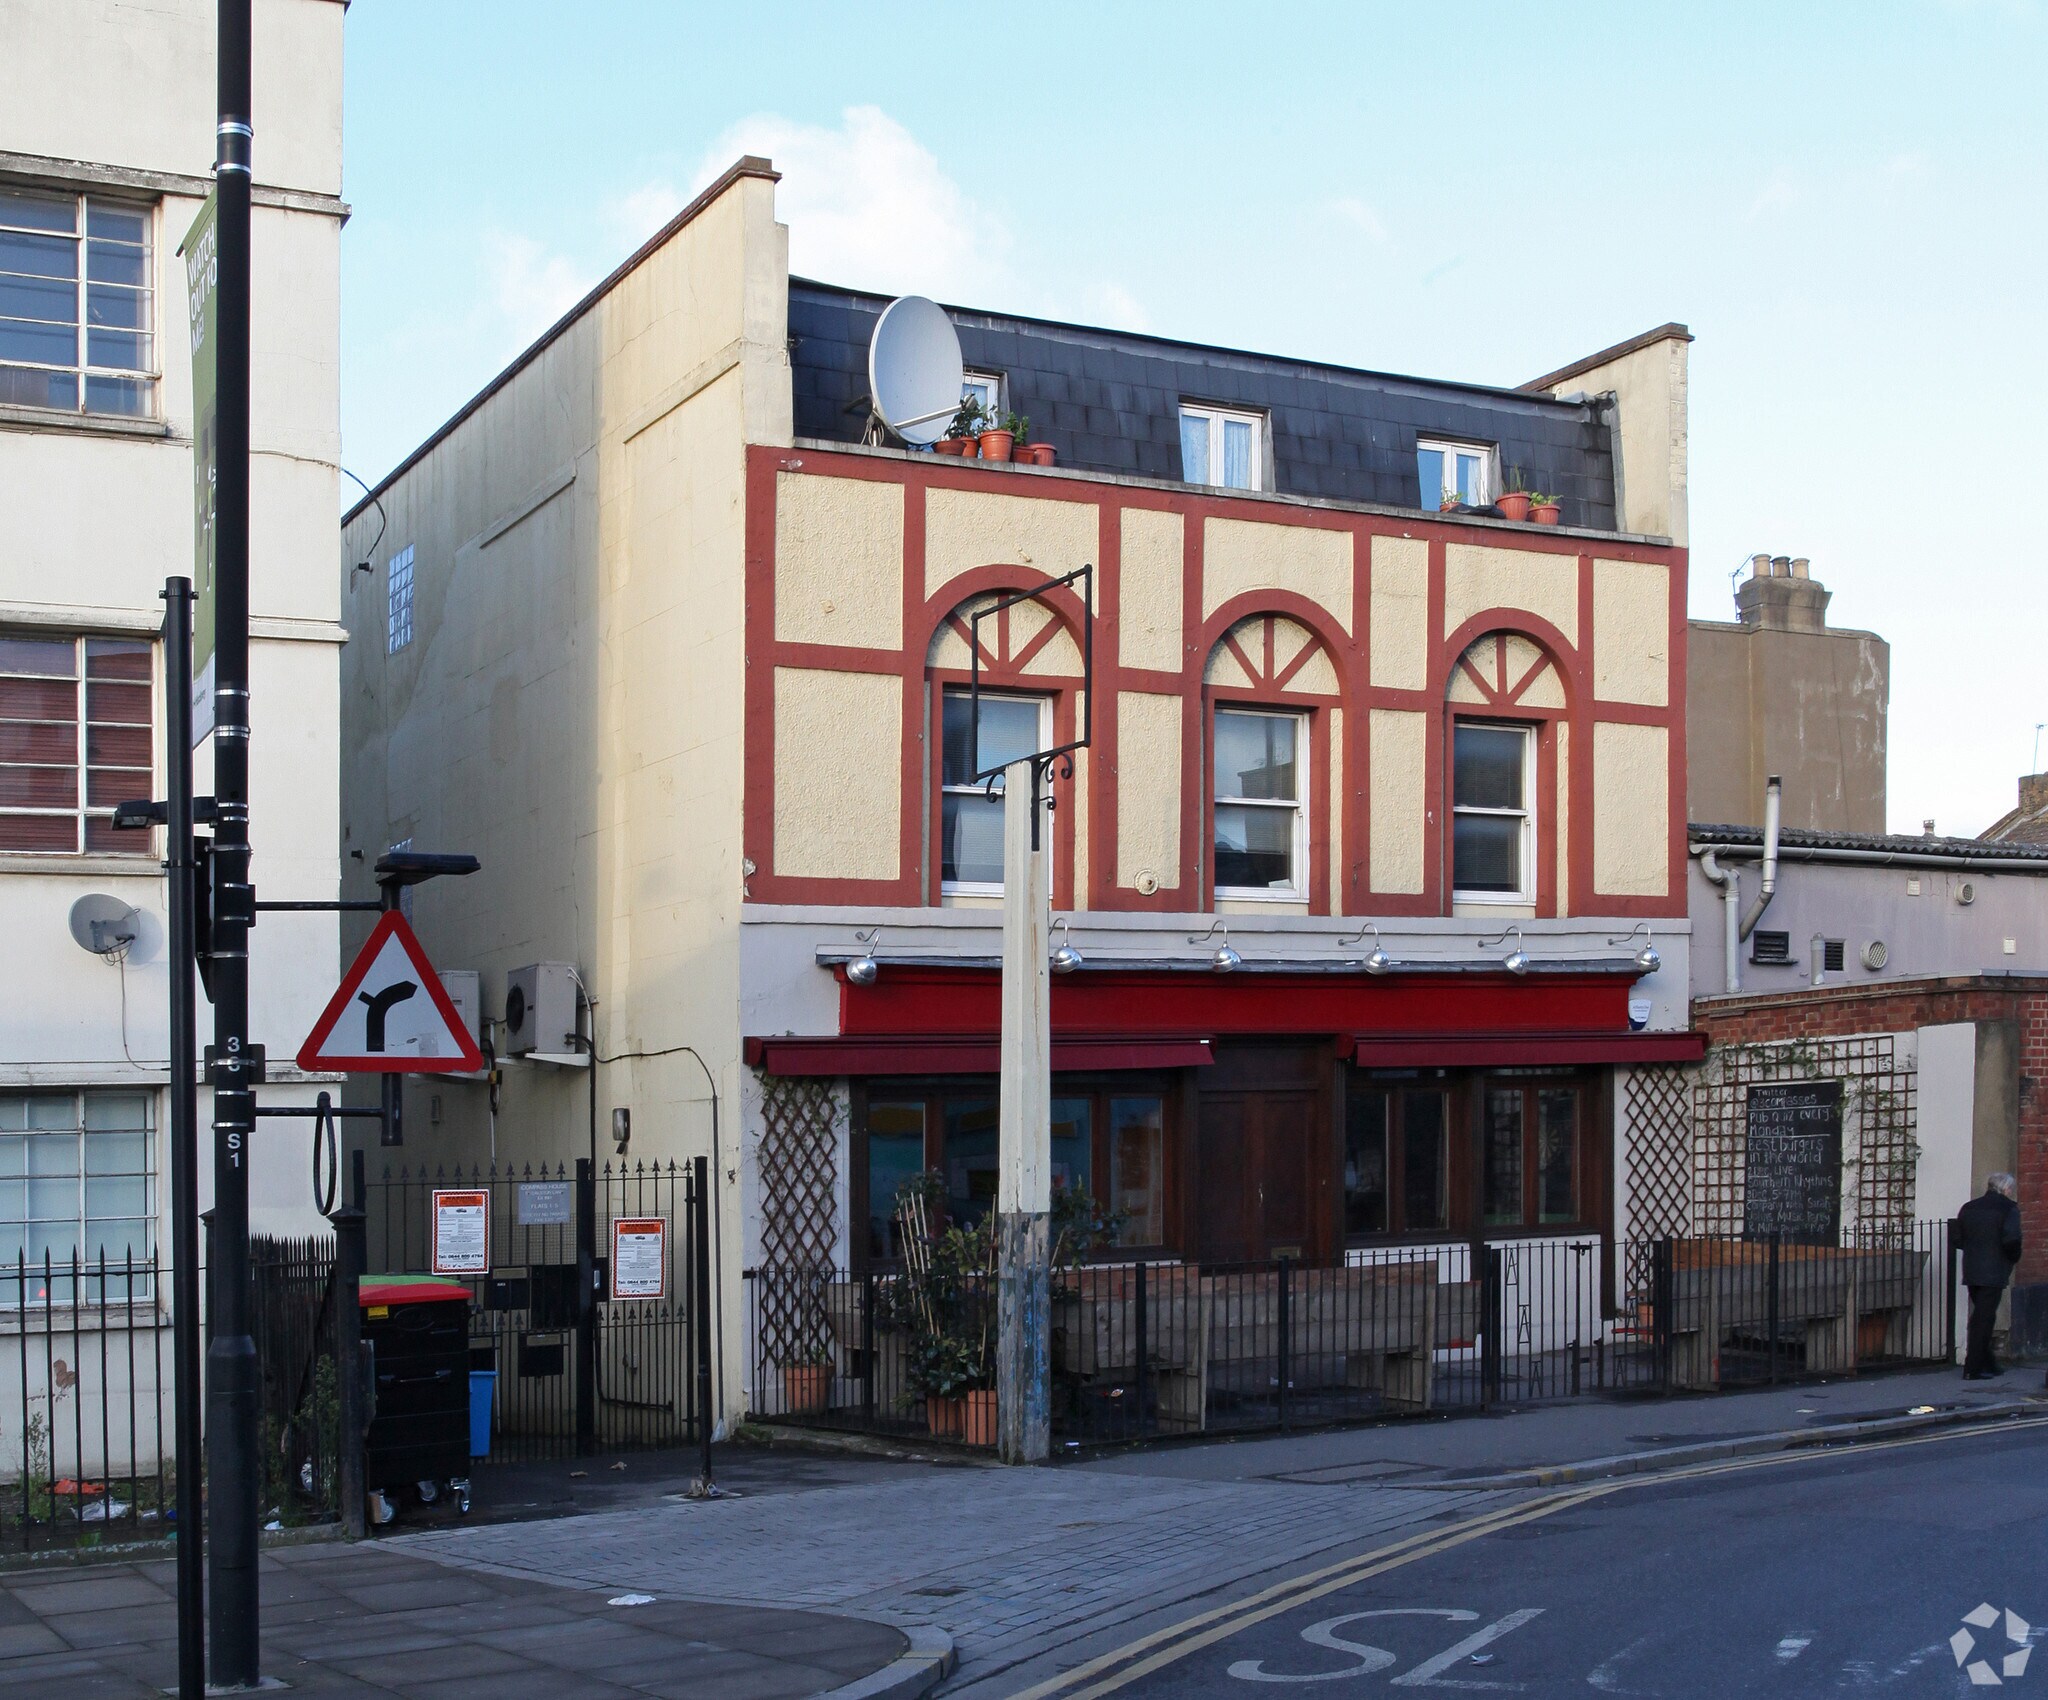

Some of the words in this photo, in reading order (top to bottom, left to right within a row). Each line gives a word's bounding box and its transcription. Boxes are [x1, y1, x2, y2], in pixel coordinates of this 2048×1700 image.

[188, 222, 216, 287] WATCH
[190, 273, 206, 321] OUT
[1749, 1124, 1795, 1137] Monday
[1748, 1137, 1777, 1151] Best
[1780, 1136, 1824, 1154] burgers
[1750, 1153, 1760, 1163] in
[1764, 1151, 1783, 1164] the
[1787, 1151, 1822, 1164] world
